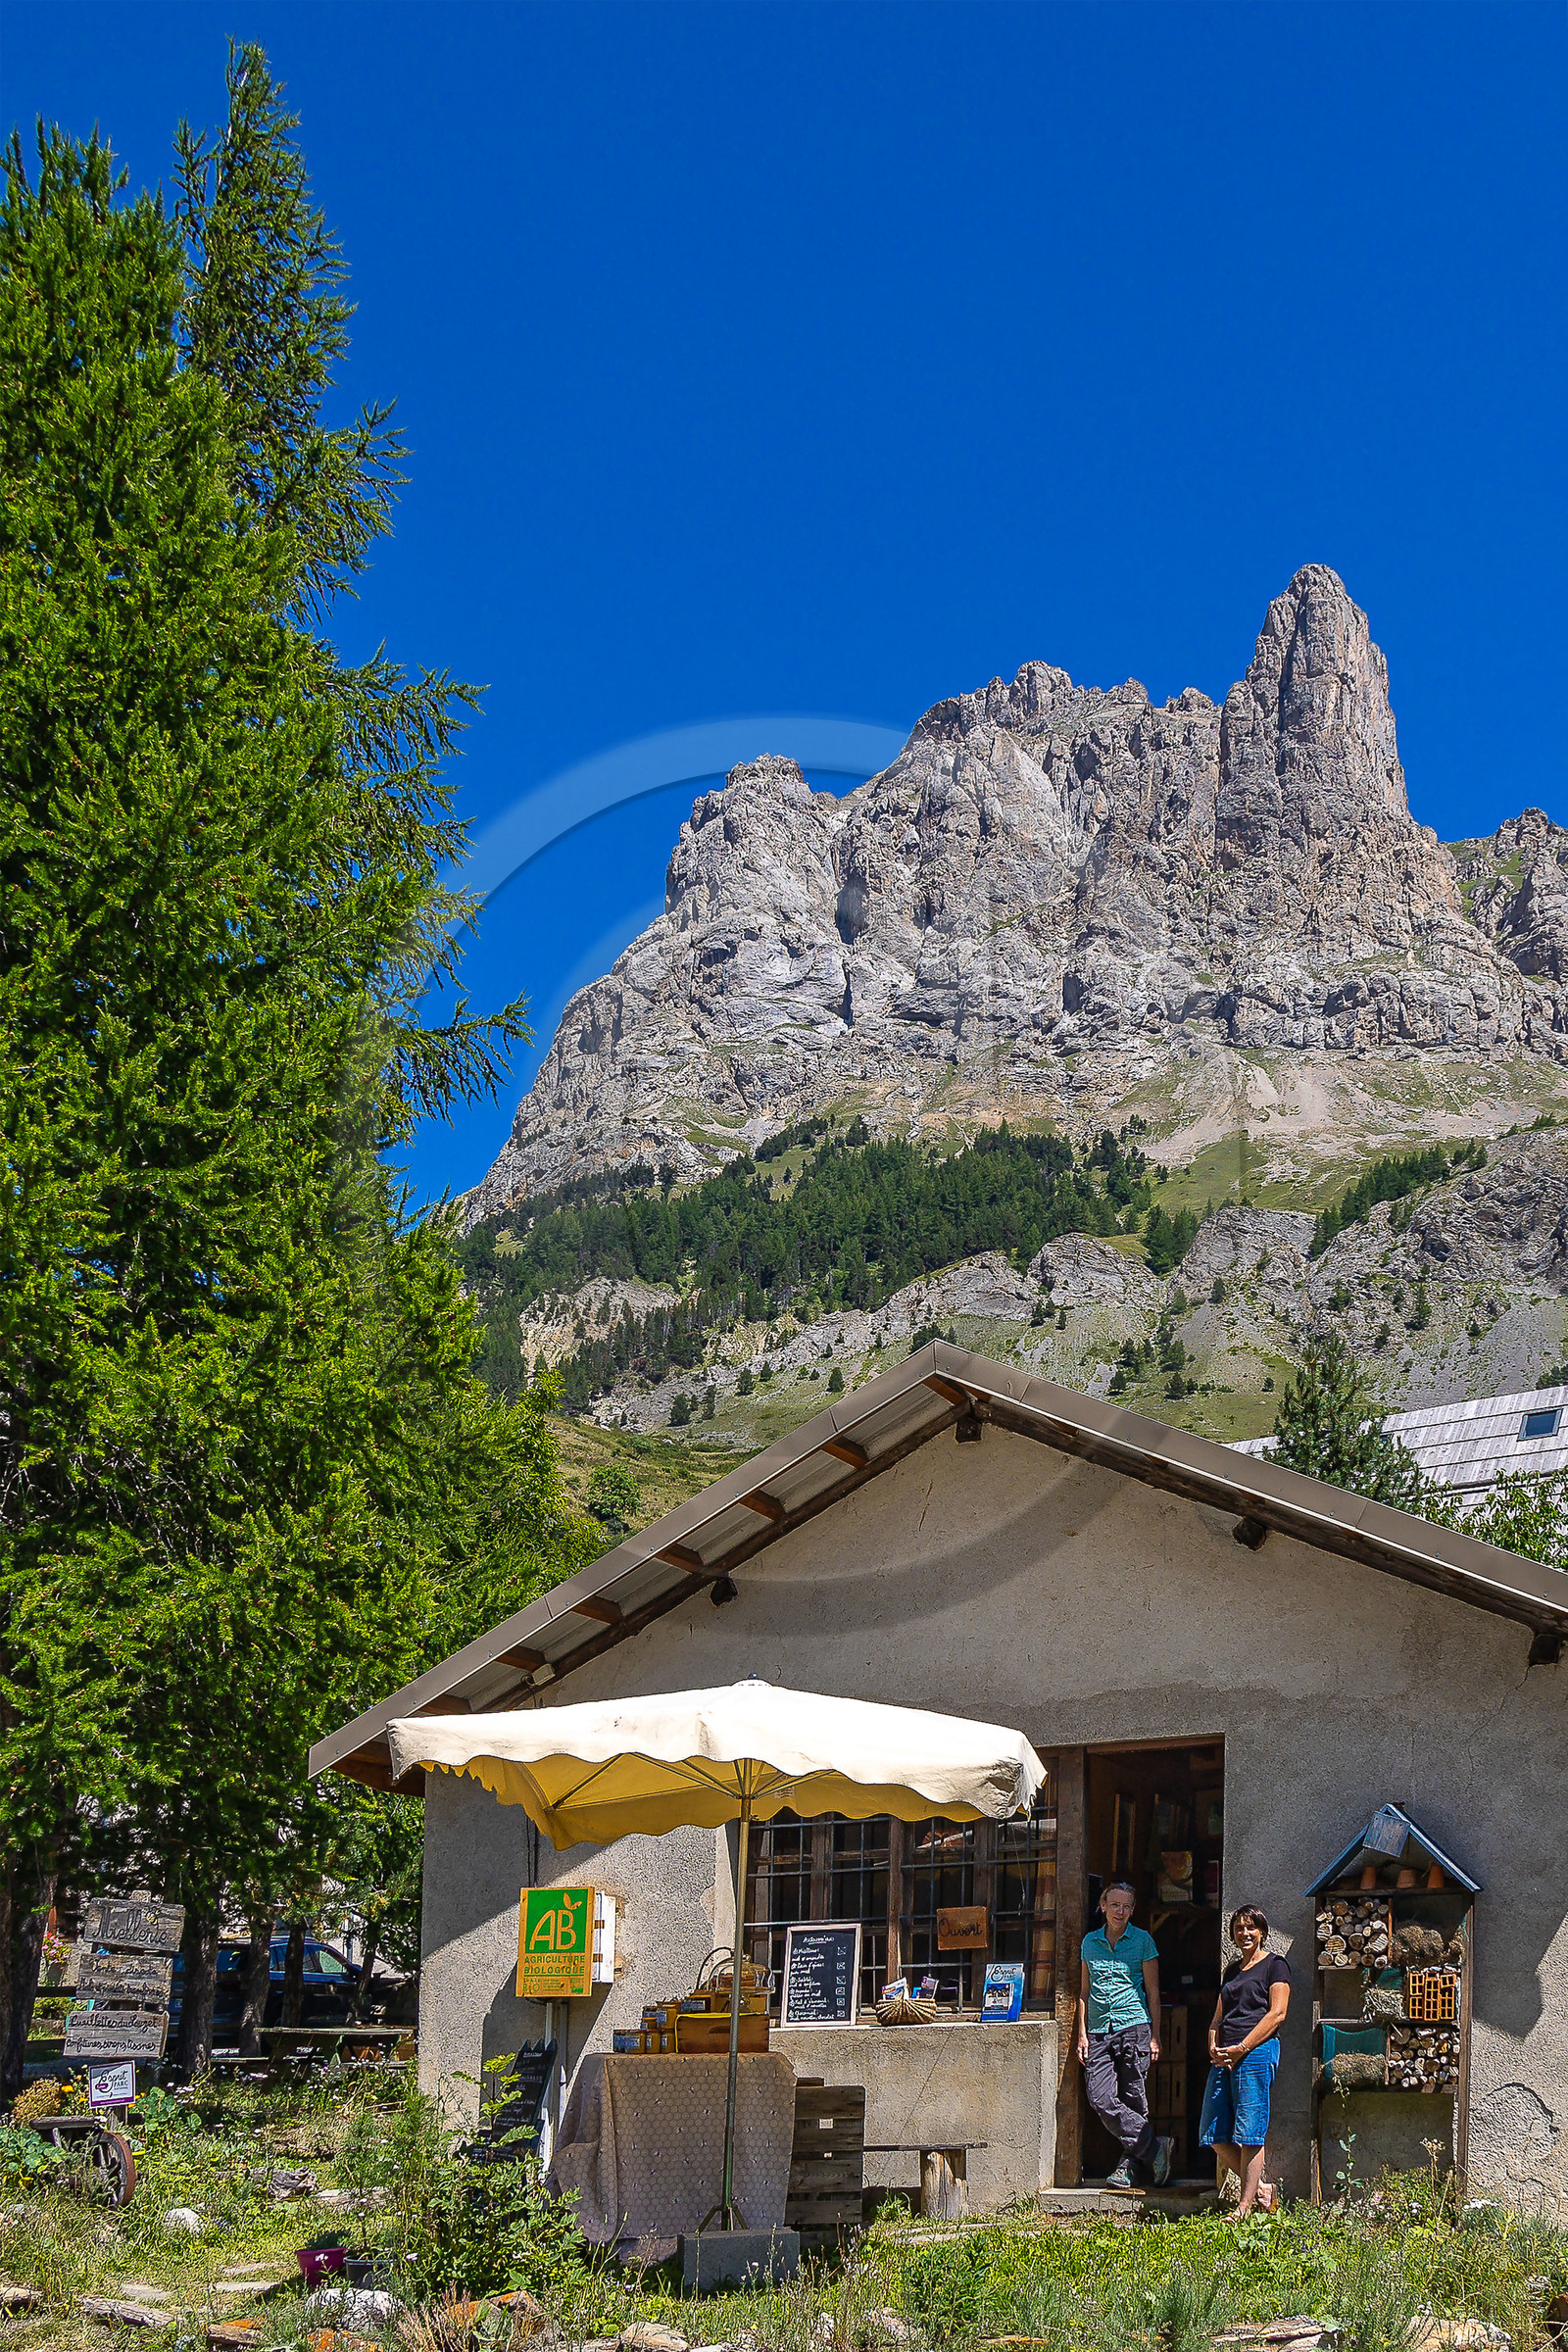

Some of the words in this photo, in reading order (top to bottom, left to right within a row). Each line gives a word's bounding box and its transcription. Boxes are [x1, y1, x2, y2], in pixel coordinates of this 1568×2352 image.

[93, 1906, 168, 1944] Miellerie
[529, 1909, 576, 1950] AB
[938, 1917, 983, 1937] Ouvert
[524, 1955, 585, 1964] AGRICULTURE
[523, 1966, 585, 1975] BIOLOGIQUE
